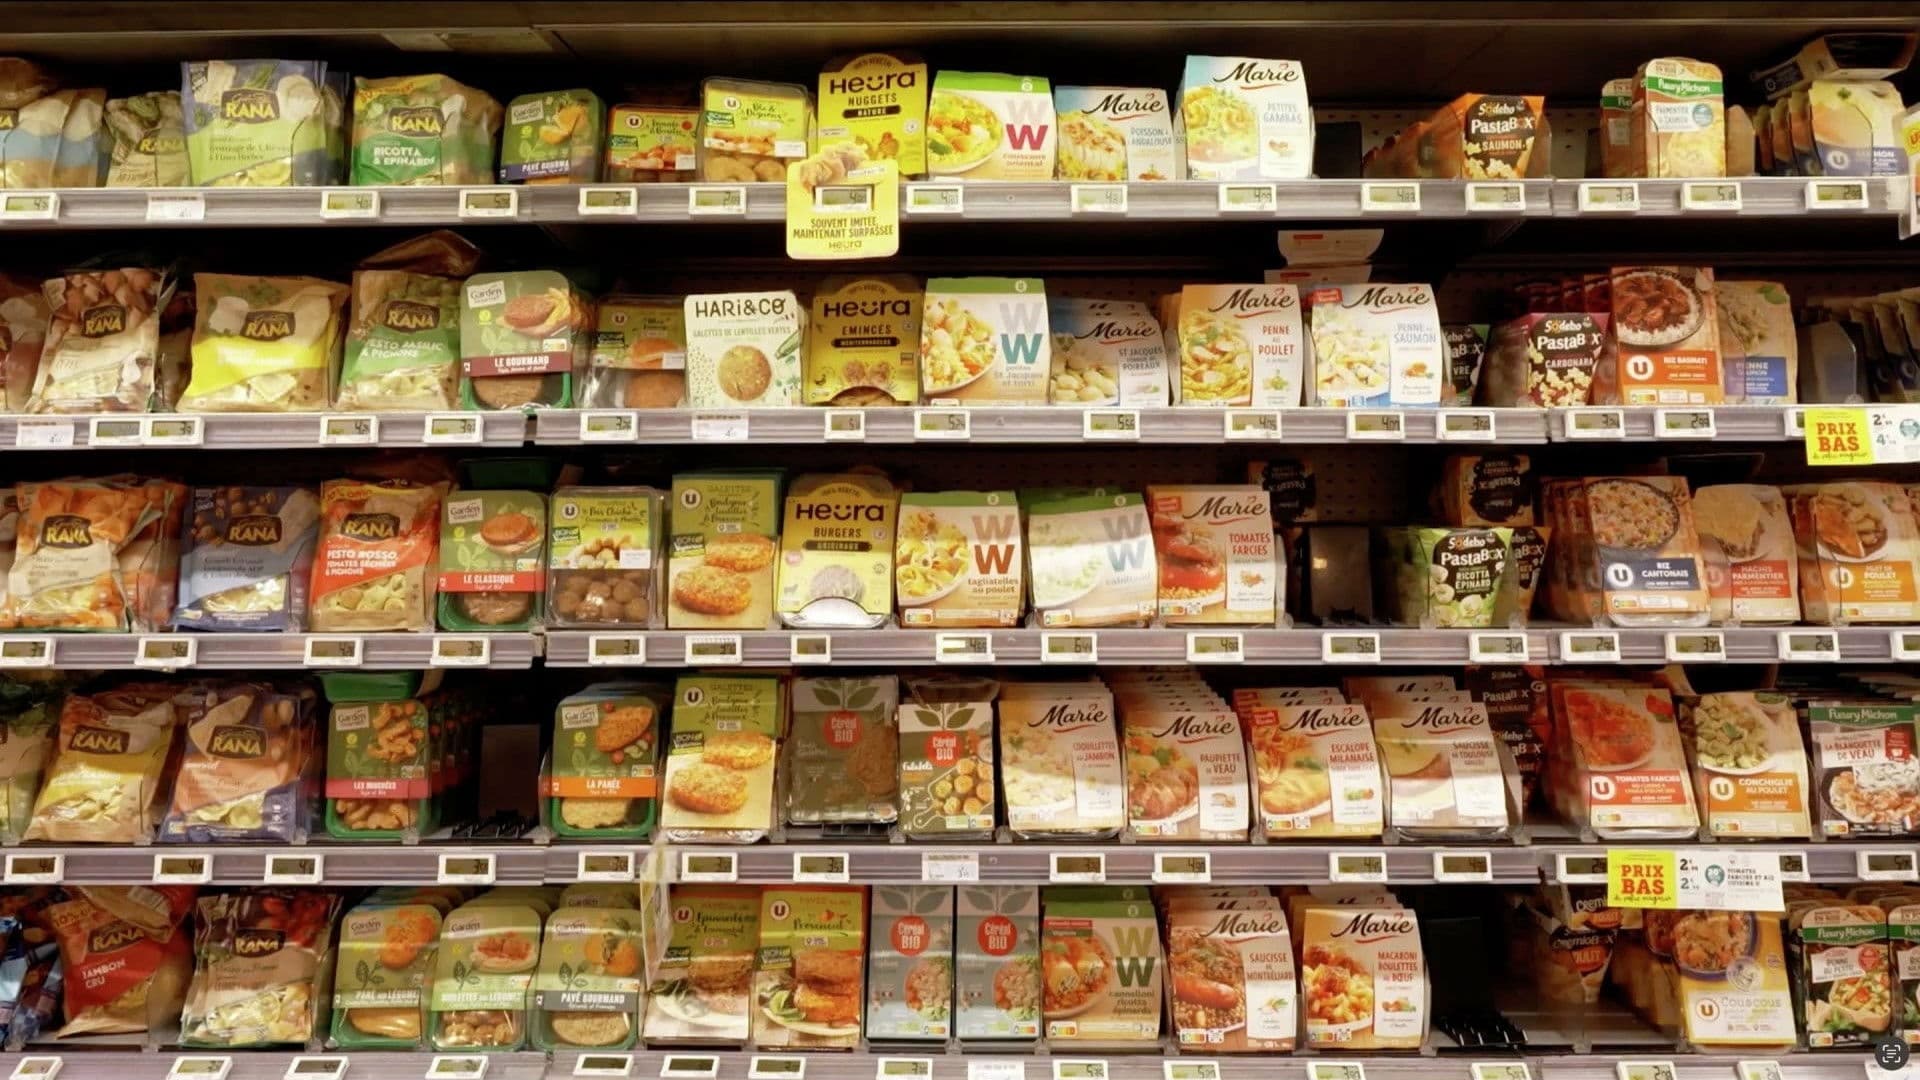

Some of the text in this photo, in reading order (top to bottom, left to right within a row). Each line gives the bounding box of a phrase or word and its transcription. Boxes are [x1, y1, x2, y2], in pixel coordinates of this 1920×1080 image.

[1213, 61, 1299, 83] Marie
[848, 94, 897, 105] NUGGETS
[1082, 93, 1164, 115] Marie
[226, 100, 275, 119] RANA
[857, 109, 887, 117] NATURE
[391, 116, 440, 132] RANA
[1263, 113, 1301, 123] GAMBAS
[1006, 124, 1049, 150] W
[1482, 139, 1522, 150] SAUMON
[373, 147, 422, 157] RICOTTA
[811, 218, 847, 228] SOUVENT
[793, 227, 846, 239] MAINTENANT
[470, 286, 502, 299] Garden
[1343, 286, 1430, 308] Marie
[1208, 289, 1295, 312] Marie
[388, 311, 433, 328] RANA
[1001, 303, 1042, 331] W
[86, 319, 122, 335] RANA
[246, 321, 290, 337] RANA
[693, 328, 722, 338] GALETTES
[768, 326, 791, 335] VERTES
[1075, 321, 1156, 341] Marie
[1262, 325, 1289, 335] PENNE
[1393, 332, 1437, 344] SAUMON
[1001, 333, 1043, 364] W
[1130, 347, 1163, 357] JACQUES
[1258, 344, 1294, 355] POULET
[506, 355, 549, 366] GOURMAND
[1122, 361, 1161, 371] POIREAUX
[1545, 357, 1594, 369] CARBONARA
[1816, 423, 1857, 435] PRIX
[1819, 436, 1860, 452] BAS
[687, 492, 696, 504] U
[451, 505, 481, 516] Garden
[1182, 497, 1267, 519] Marie
[345, 521, 394, 538] RANA
[813, 526, 861, 538] BURGERS
[971, 515, 1015, 542] W
[1104, 514, 1144, 541] W
[45, 527, 91, 544] RANA
[229, 526, 278, 542] RANA
[1228, 533, 1271, 544] TOMATES
[327, 550, 356, 559] PESTO
[1108, 540, 1147, 572] W
[1232, 544, 1268, 556] FARCIES
[327, 560, 359, 568] TOMATES
[974, 544, 1015, 575] W
[463, 574, 515, 585] LE CLASSIQUE
[1456, 571, 1490, 581] RICOTTA
[1616, 566, 1627, 582] U
[1642, 569, 1689, 578] CANTONAIS
[1732, 573, 1784, 581] PARMENTIER
[1864, 572, 1897, 581] POULET
[968, 577, 1019, 587] tagliatelles
[986, 585, 1016, 595] poulet
[687, 690, 698, 703] U
[338, 713, 366, 724] Garden
[565, 710, 595, 722] Garden
[1029, 704, 1110, 729] Marie
[1281, 708, 1363, 731] Marie
[1402, 706, 1484, 729] Marie
[1861, 709, 1897, 721] Michon
[1153, 715, 1235, 739] Marie
[72, 732, 122, 753] RANA
[834, 730, 853, 743] BIO
[211, 736, 262, 754] RANA
[1073, 742, 1115, 751] COQUILLETTES
[1331, 742, 1370, 754] ESCALOPE
[1453, 741, 1489, 751] SAUCISSE
[1834, 739, 1881, 751] BLANQUETTE
[936, 748, 954, 761] BIO
[1084, 752, 1115, 762] JAMBON
[1200, 752, 1240, 764] PAUPIETTE
[1330, 753, 1375, 764] MILANAISE
[1838, 749, 1875, 760] DE VEAU
[1213, 763, 1237, 774] VEAU
[586, 781, 595, 789] LA
[1616, 775, 1681, 784] TOMATES FARCIES
[1739, 778, 1793, 788] CONCHIGLIE
[1596, 780, 1609, 796] U
[1715, 782, 1726, 794] U
[1621, 864, 1664, 879] PRIX
[1622, 879, 1665, 895] BAS
[774, 905, 785, 917] U
[351, 919, 381, 932] Garden
[451, 921, 480, 933] Garden
[1200, 915, 1282, 938] Marie
[1331, 914, 1414, 938] Marie
[1846, 926, 1875, 937] Michon
[93, 928, 145, 949] RANA
[902, 936, 920, 949] BIO
[988, 936, 1008, 950] BIO
[1112, 927, 1154, 956] W
[235, 938, 278, 953] RANA
[1249, 952, 1287, 964] SAUCISSE
[1378, 951, 1418, 962] MACARONI
[82, 958, 126, 979] JAMBON
[1116, 957, 1155, 987] W
[1378, 961, 1419, 972] BOULETTES
[583, 993, 625, 1004] GOURMAND
[1720, 996, 1781, 1009] Couscous
[1701, 1004, 1714, 1017] U
